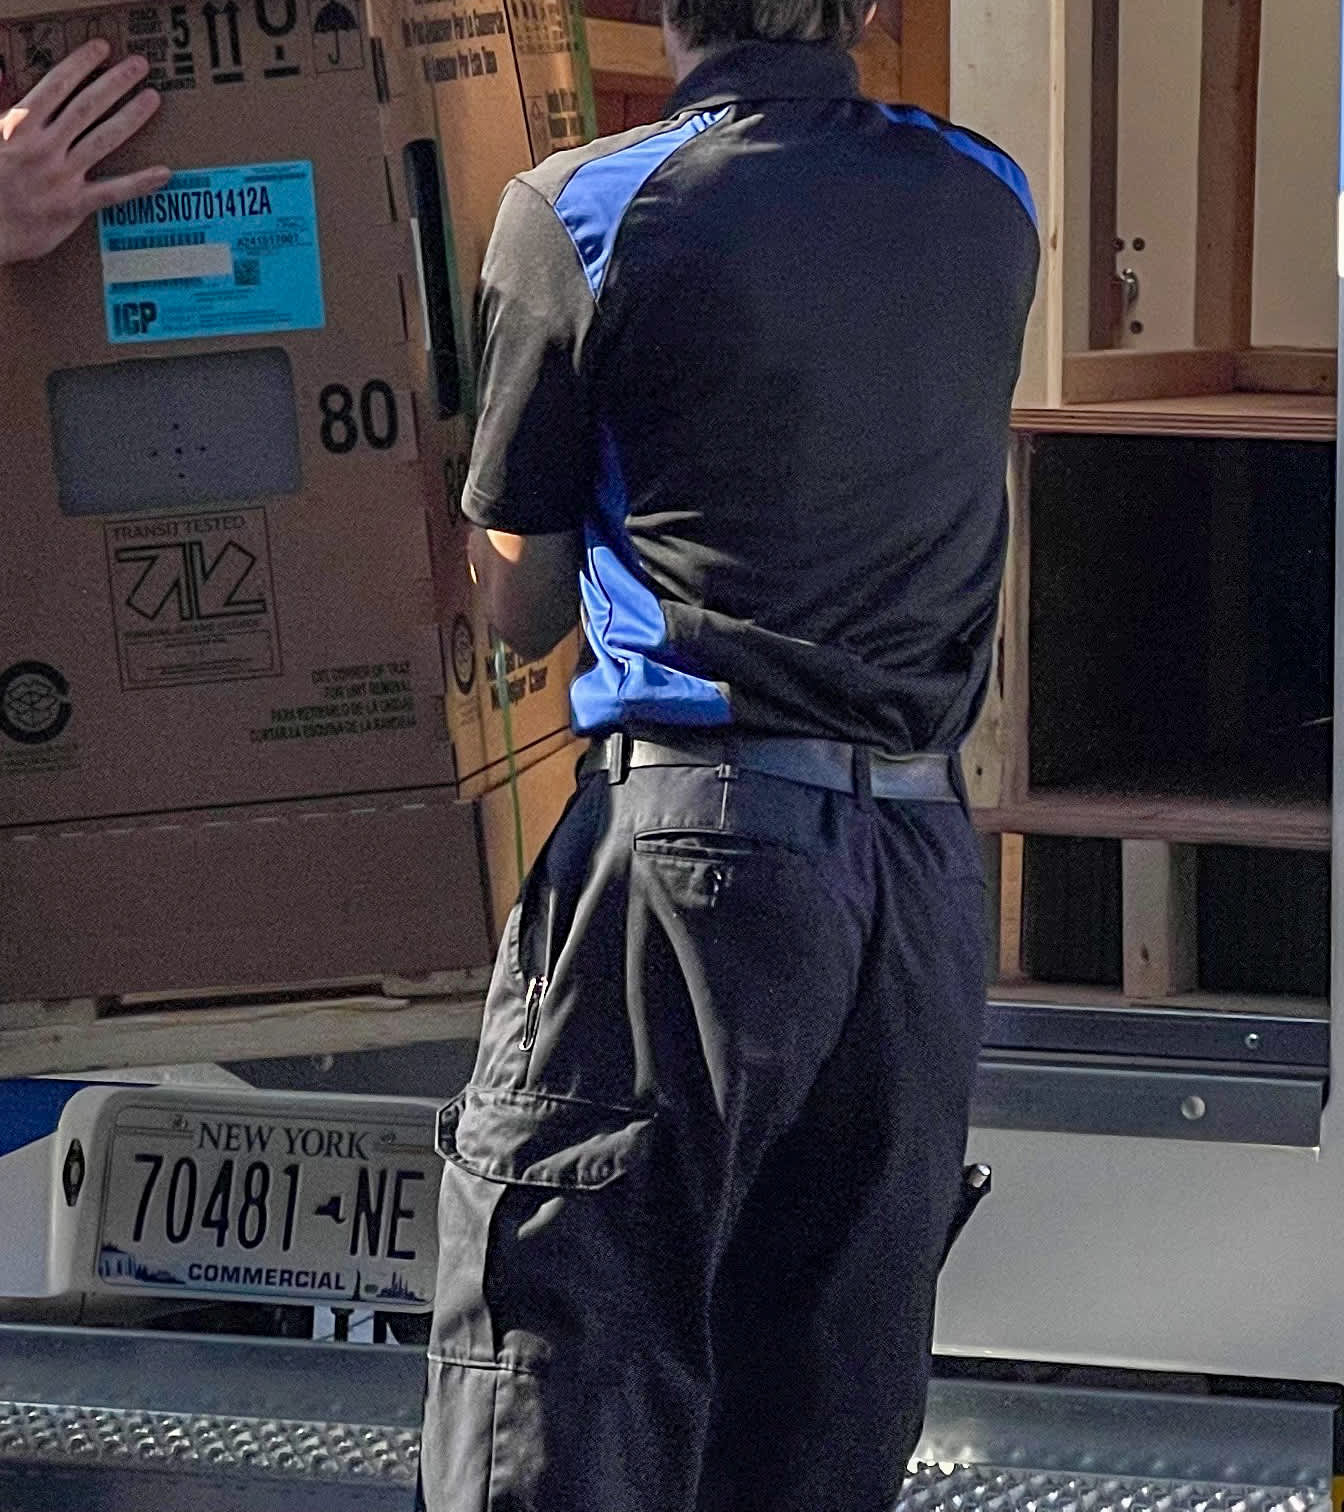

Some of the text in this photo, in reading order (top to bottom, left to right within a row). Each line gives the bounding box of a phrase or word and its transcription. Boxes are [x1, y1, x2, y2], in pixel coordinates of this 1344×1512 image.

[169, 4, 191, 50] 5
[318, 379, 399, 455] 80
[112, 515, 247, 541] TRANSIT TESTED
[198, 1121, 372, 1160] NEW YORK
[188, 1261, 346, 1291] COMMERCIAL
